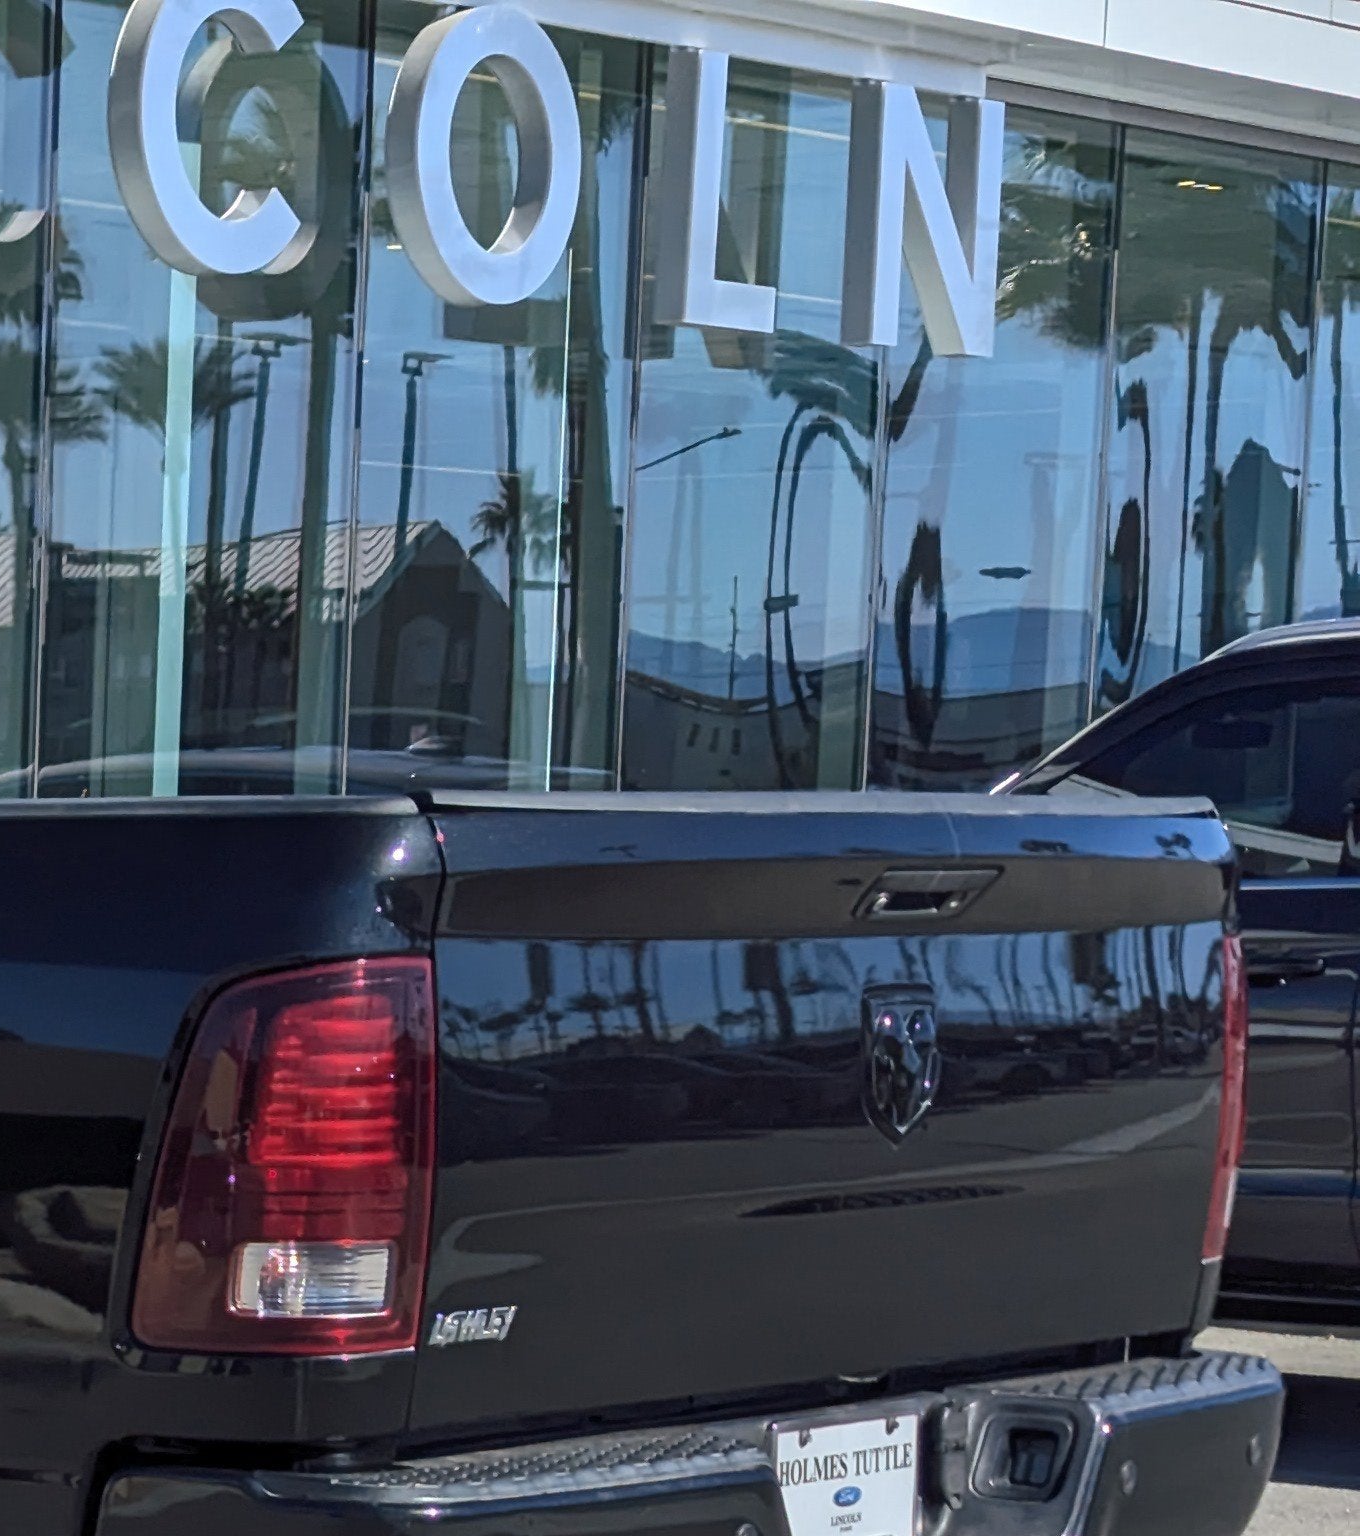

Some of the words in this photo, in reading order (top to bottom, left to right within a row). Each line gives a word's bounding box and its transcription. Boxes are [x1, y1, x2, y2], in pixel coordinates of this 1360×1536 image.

[779, 1453, 848, 1487] HOLMES
[853, 1442, 913, 1477] TUTTLE
[830, 1512, 863, 1527] LINCOLN
